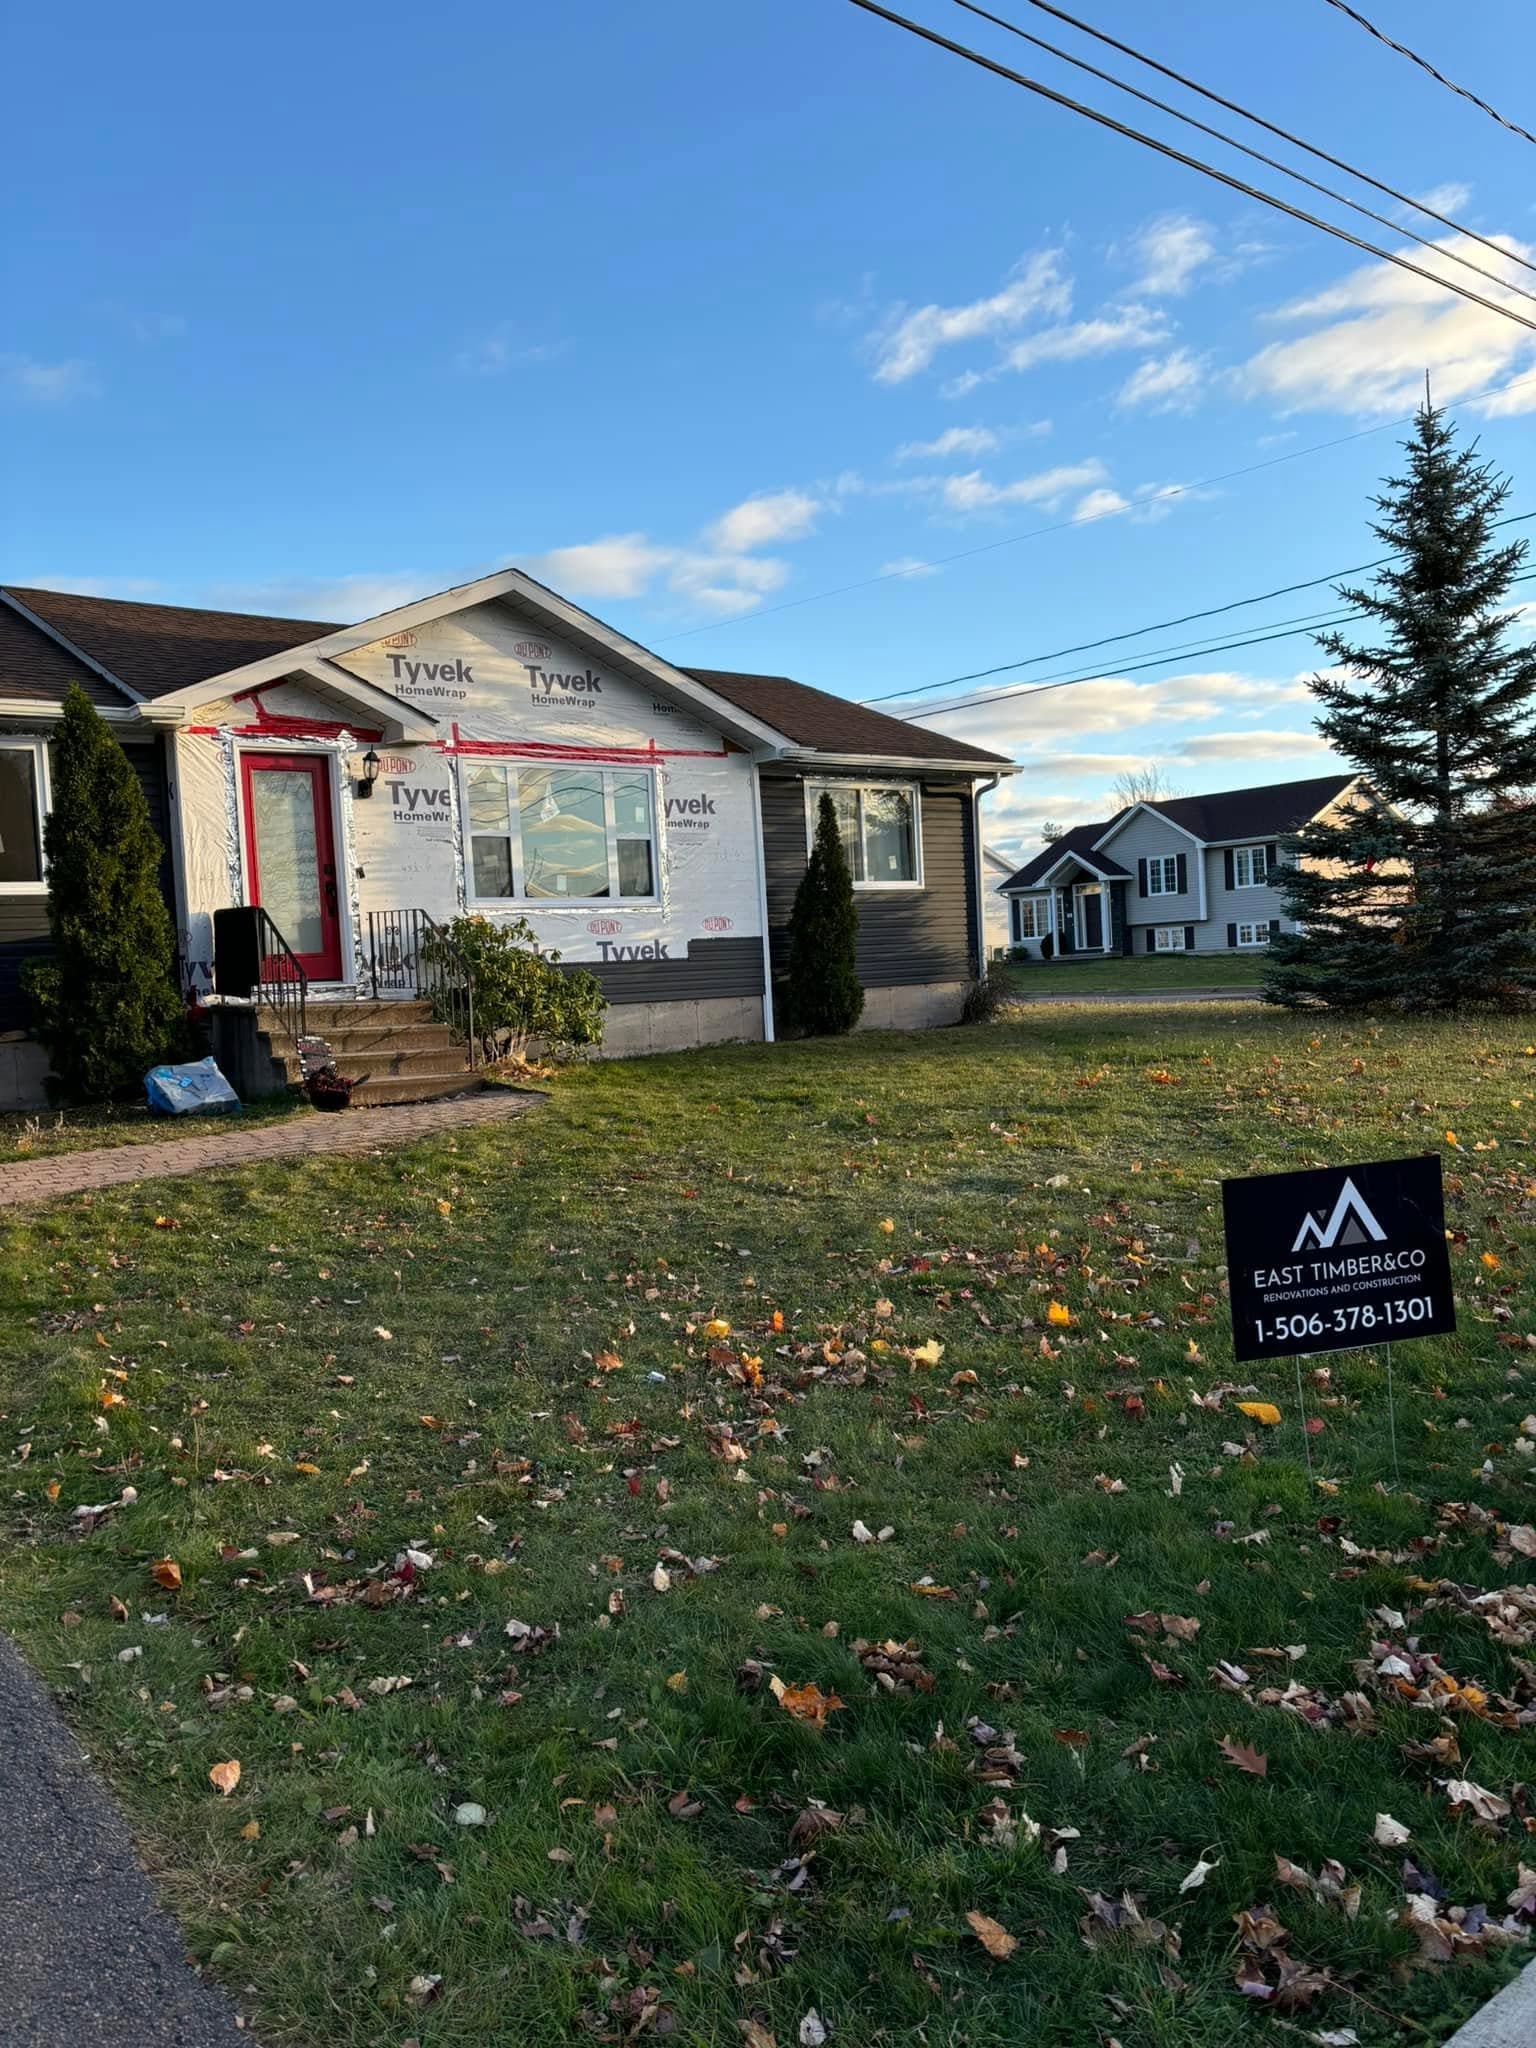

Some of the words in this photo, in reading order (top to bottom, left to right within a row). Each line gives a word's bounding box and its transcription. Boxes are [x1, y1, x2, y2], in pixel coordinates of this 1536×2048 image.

[385, 653, 475, 685] Tyvek
[524, 665, 602, 695] Tyvek
[395, 684, 467, 700] HomeWrap
[531, 694, 596, 708] HomeWrap
[385, 781, 451, 811] Tyve
[664, 793, 716, 818] yvek
[393, 810, 450, 822] HomeWr
[665, 819, 710, 829] meWrap
[596, 939, 670, 962] Tyvek
[1254, 1265, 1304, 1288] EAST
[1310, 1249, 1426, 1281] TIMBER&CO
[1263, 1286, 1329, 1304] RENOVATIONS
[1330, 1284, 1351, 1294] AND
[1352, 1273, 1422, 1292] CONSTRUCTION
[1255, 1296, 1433, 1343] 1-506-378-1301
